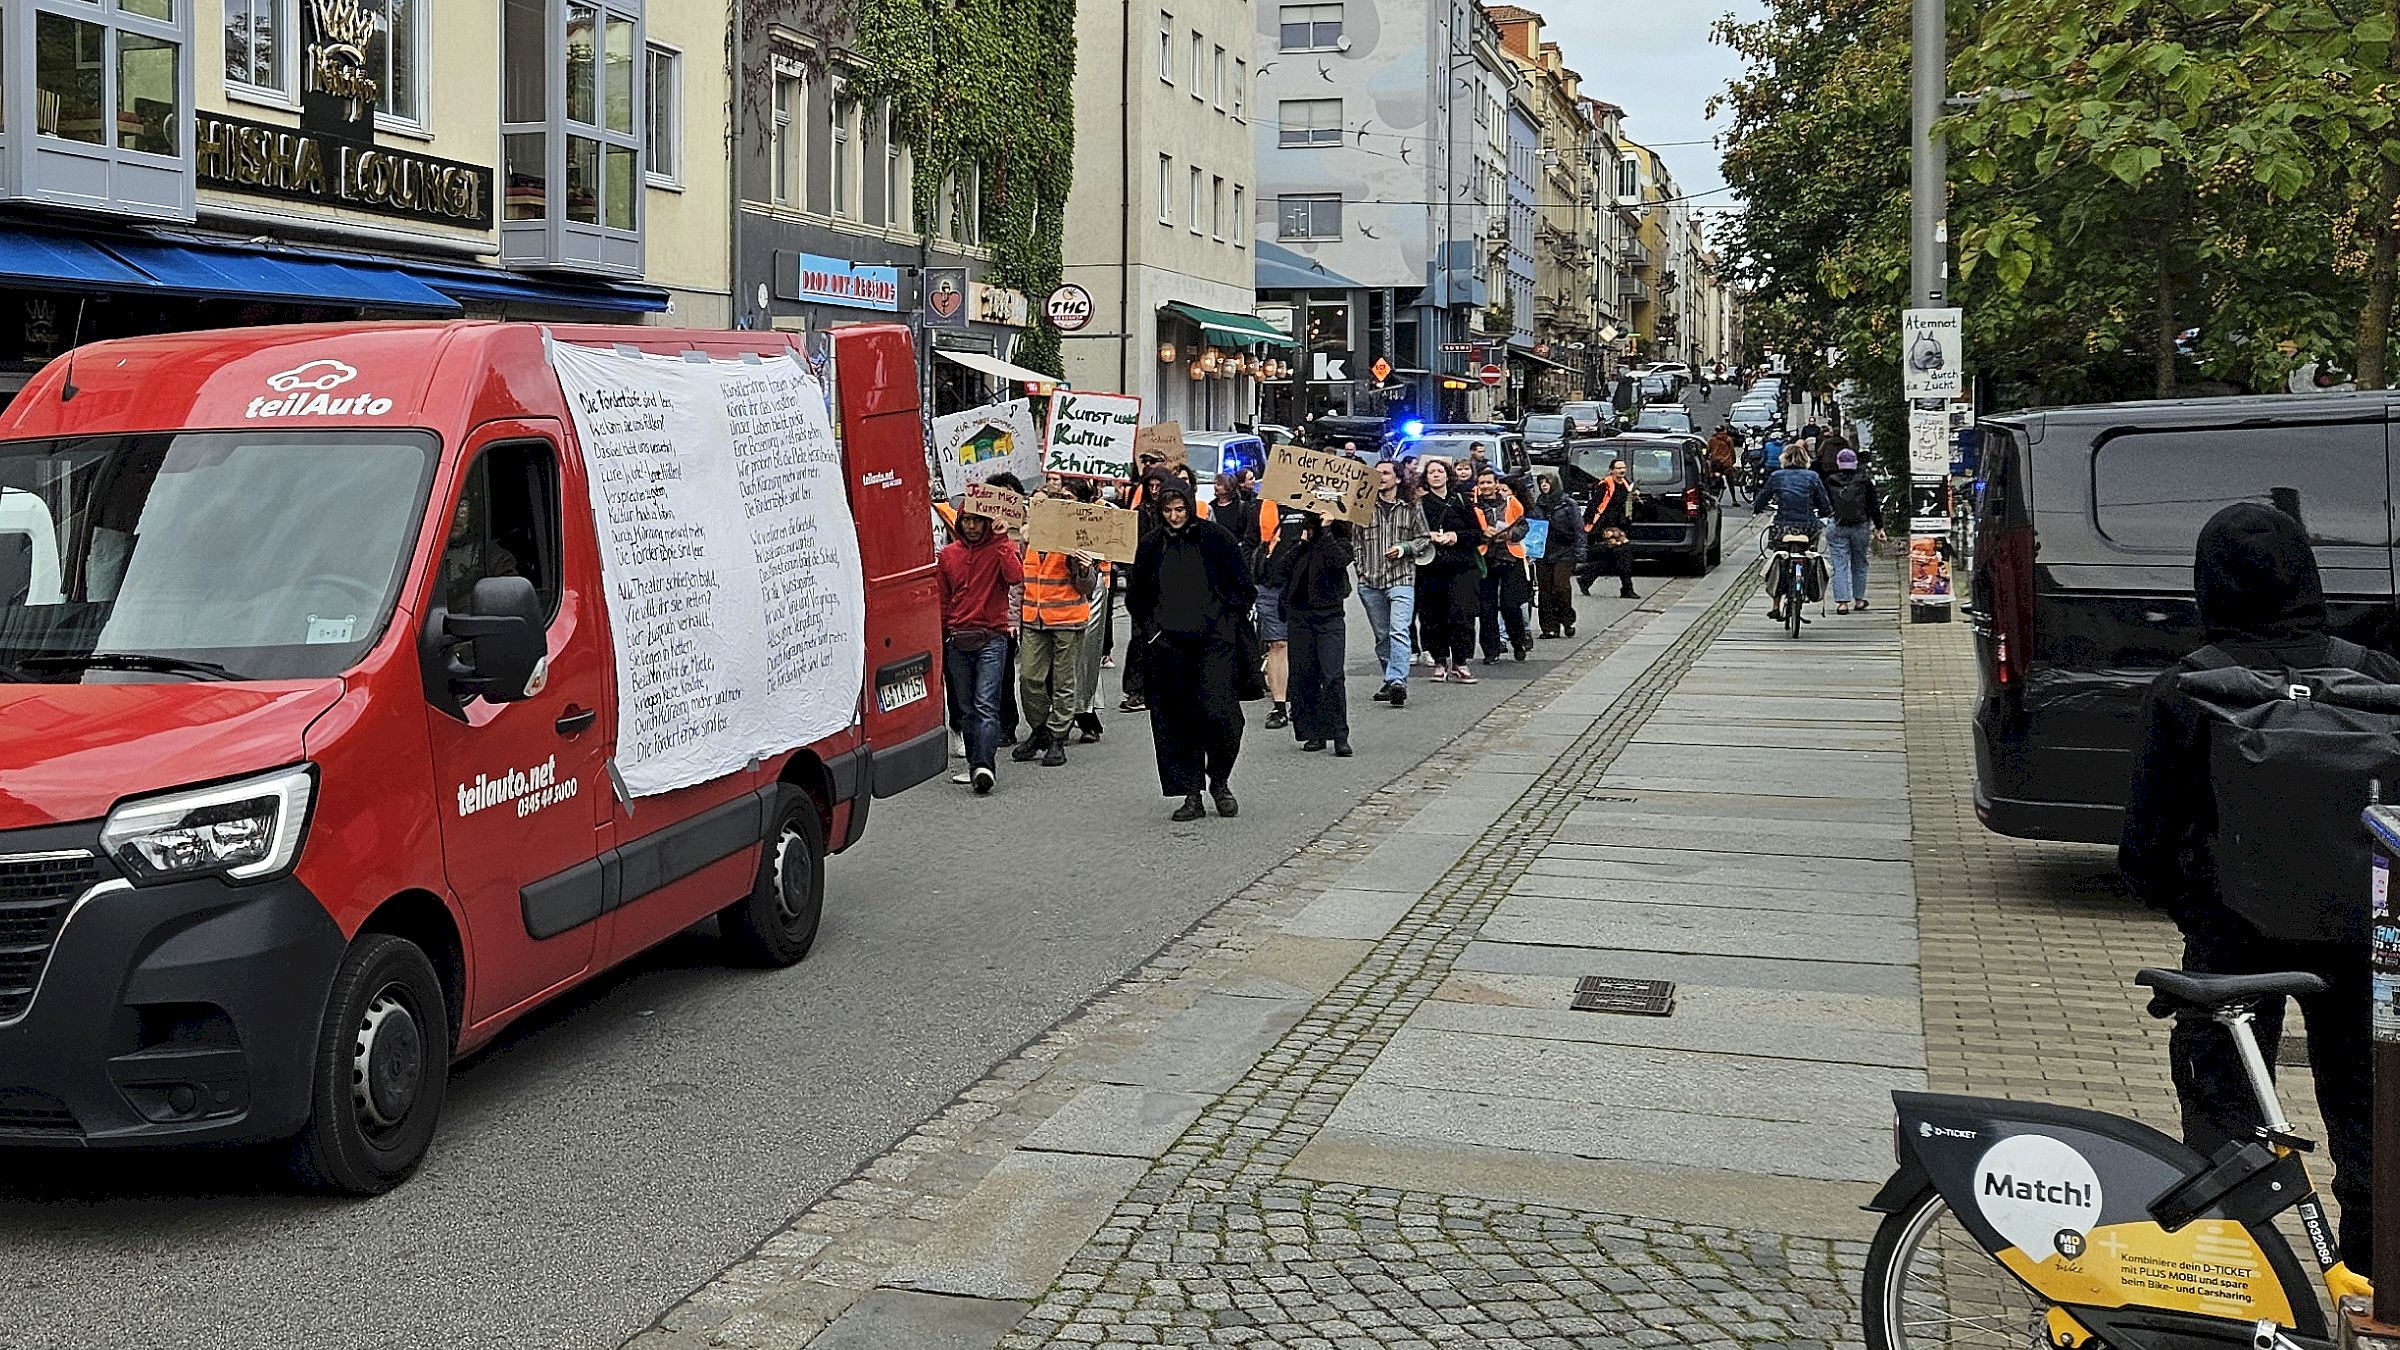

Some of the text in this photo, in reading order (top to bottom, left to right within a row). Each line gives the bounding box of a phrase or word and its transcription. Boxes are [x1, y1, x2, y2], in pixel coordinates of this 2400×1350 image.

[196, 117, 327, 194] HISHA
[803, 271, 828, 291] DROP
[1051, 301, 1087, 314] THC
[1905, 315, 1957, 330] Atemnot
[1313, 352, 1347, 380] k
[1931, 369, 1958, 380] durch
[1923, 380, 1955, 391] Zucht
[245, 392, 393, 418] teilAuto
[579, 391, 598, 414] Die
[1053, 422, 1115, 447] Kultur
[1297, 450, 1319, 469] der
[1323, 458, 1369, 480] Kultur
[966, 484, 993, 498] Jeder
[1300, 471, 1349, 492] sparen
[616, 547, 631, 566] Die
[637, 738, 652, 762] Die
[457, 753, 556, 817] teilauto.net
[517, 791, 541, 818] 0345
[553, 777, 578, 804] 5000
[1934, 1126, 1977, 1140] D-TICKET
[1984, 1172, 2091, 1208] Match!
[2059, 1233, 2081, 1245] MO
[2063, 1243, 2077, 1255] BI
[2307, 1220, 2333, 1264] 932086
[2121, 1253, 2252, 1278] Kombiniere dein D-TICKET
[2121, 1265, 2249, 1291] mit PLUS MOBI und spare
[2121, 1276, 2255, 1304] beim Bike- und Carsharing.
